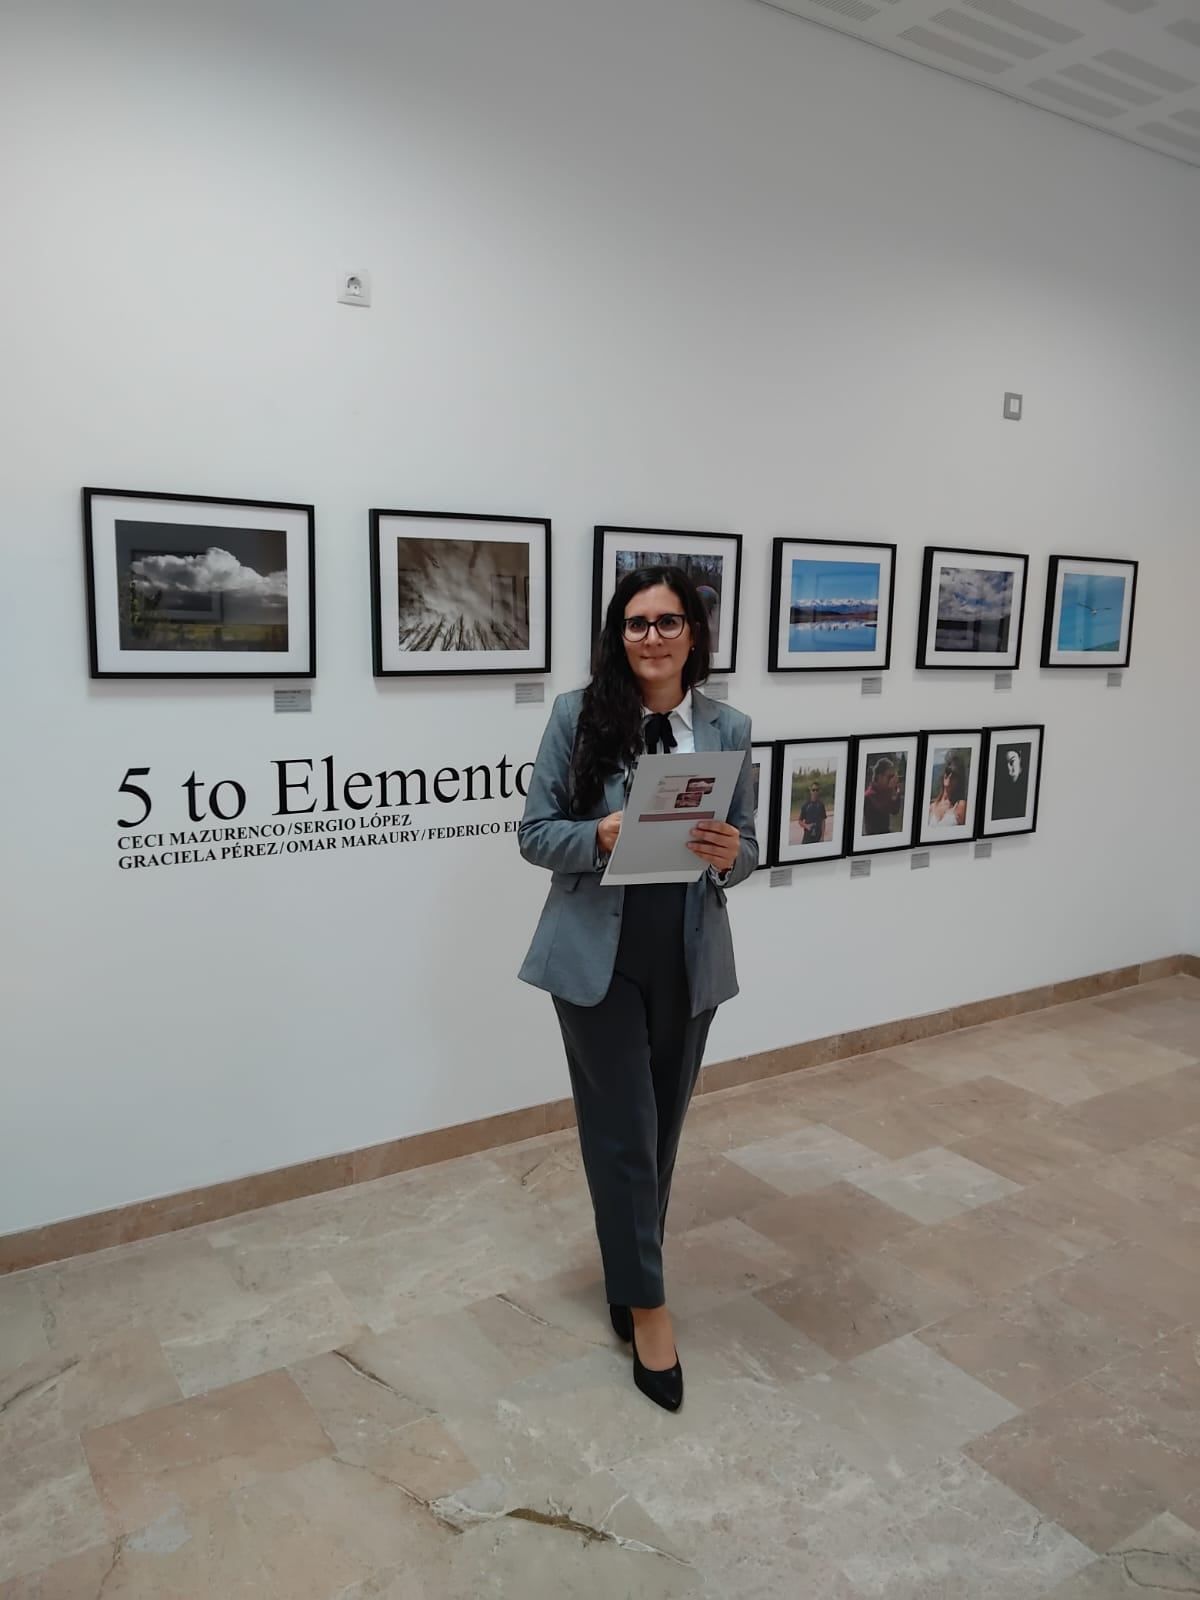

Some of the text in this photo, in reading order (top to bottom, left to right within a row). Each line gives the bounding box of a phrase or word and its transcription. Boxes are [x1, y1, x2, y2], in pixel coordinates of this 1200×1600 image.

[117, 767, 152, 828] 5
[181, 770, 247, 822] to
[117, 833, 164, 850] CECI
[360, 812, 412, 829] LÓPEZ
[118, 848, 217, 870] GRACIELA
